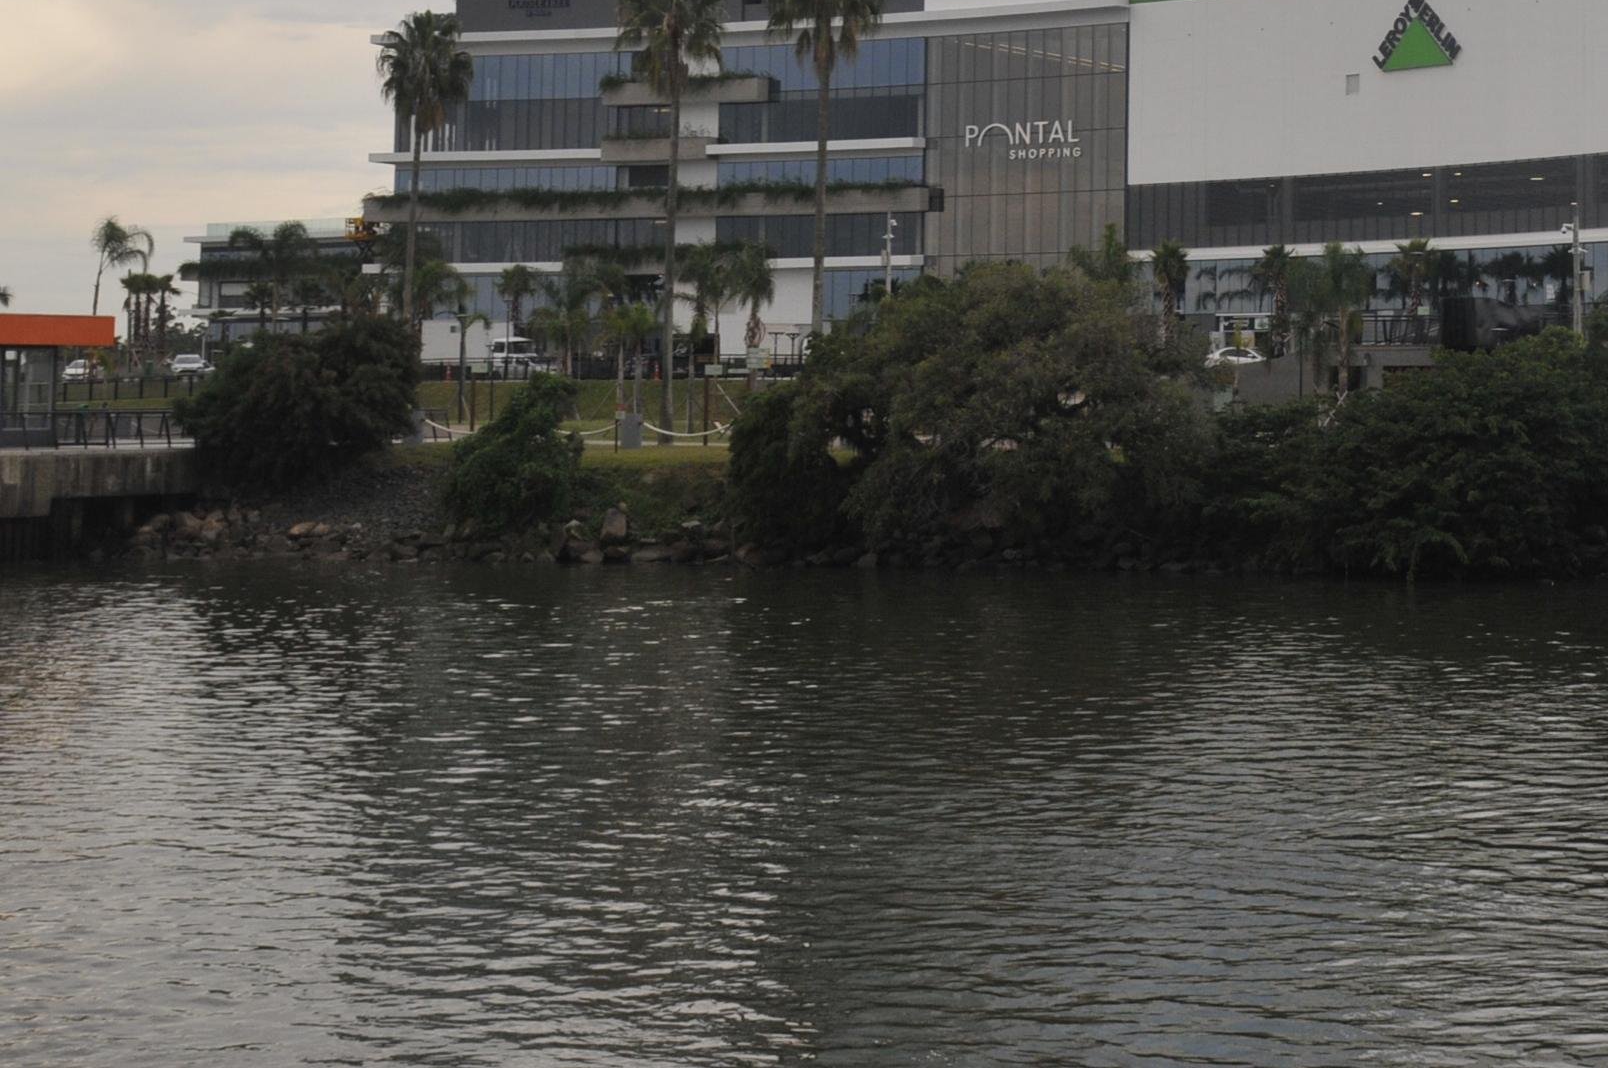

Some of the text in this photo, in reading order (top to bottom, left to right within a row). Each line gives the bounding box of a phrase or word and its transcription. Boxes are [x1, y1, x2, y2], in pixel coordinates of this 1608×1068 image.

[1372, 4, 1412, 69] LEROY
[965, 120, 1080, 147] PONTAL
[1009, 147, 1081, 160] SHOPPING
